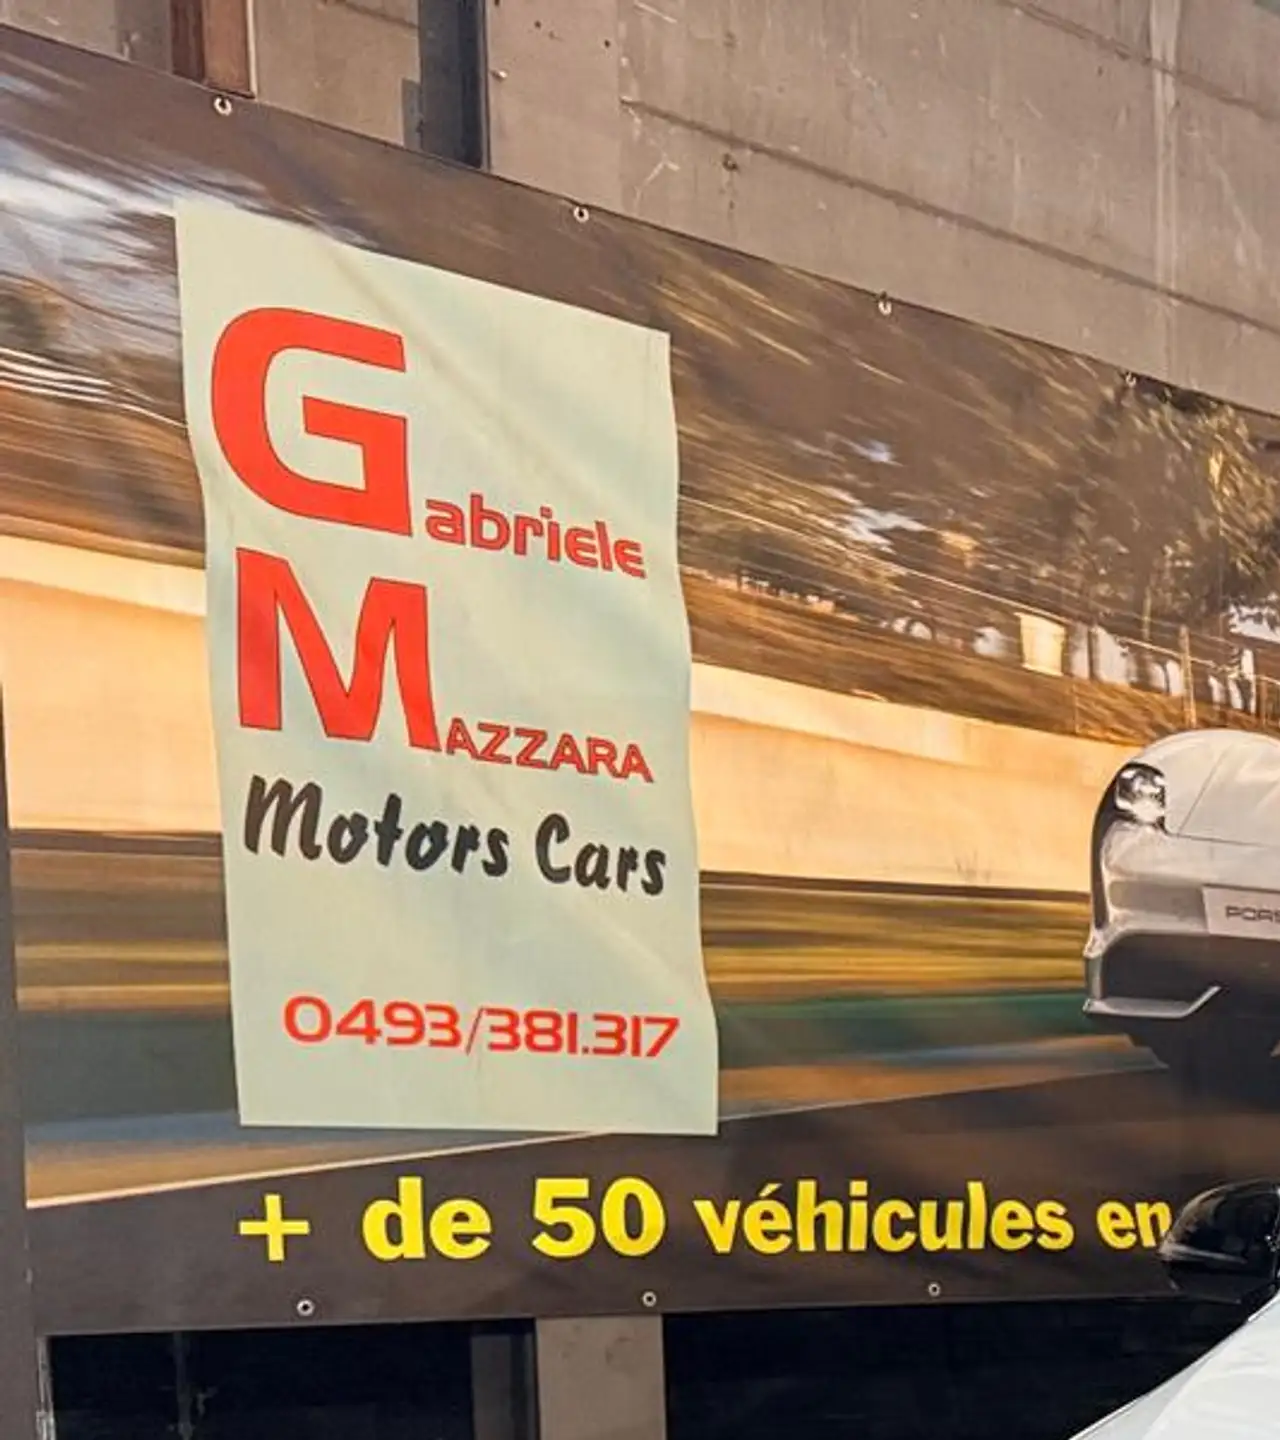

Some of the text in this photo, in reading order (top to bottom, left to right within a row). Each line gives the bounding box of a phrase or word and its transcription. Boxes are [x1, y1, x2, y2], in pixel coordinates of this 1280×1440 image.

[243, 774, 667, 896] Motors Cars
[283, 995, 680, 1058] 0493/381.317
[239, 1193, 310, 1261] +
[361, 1176, 492, 1260] de
[531, 1176, 665, 1258] 50
[693, 1178, 1074, 1254] véhicules
[1096, 1201, 1172, 1249] en
